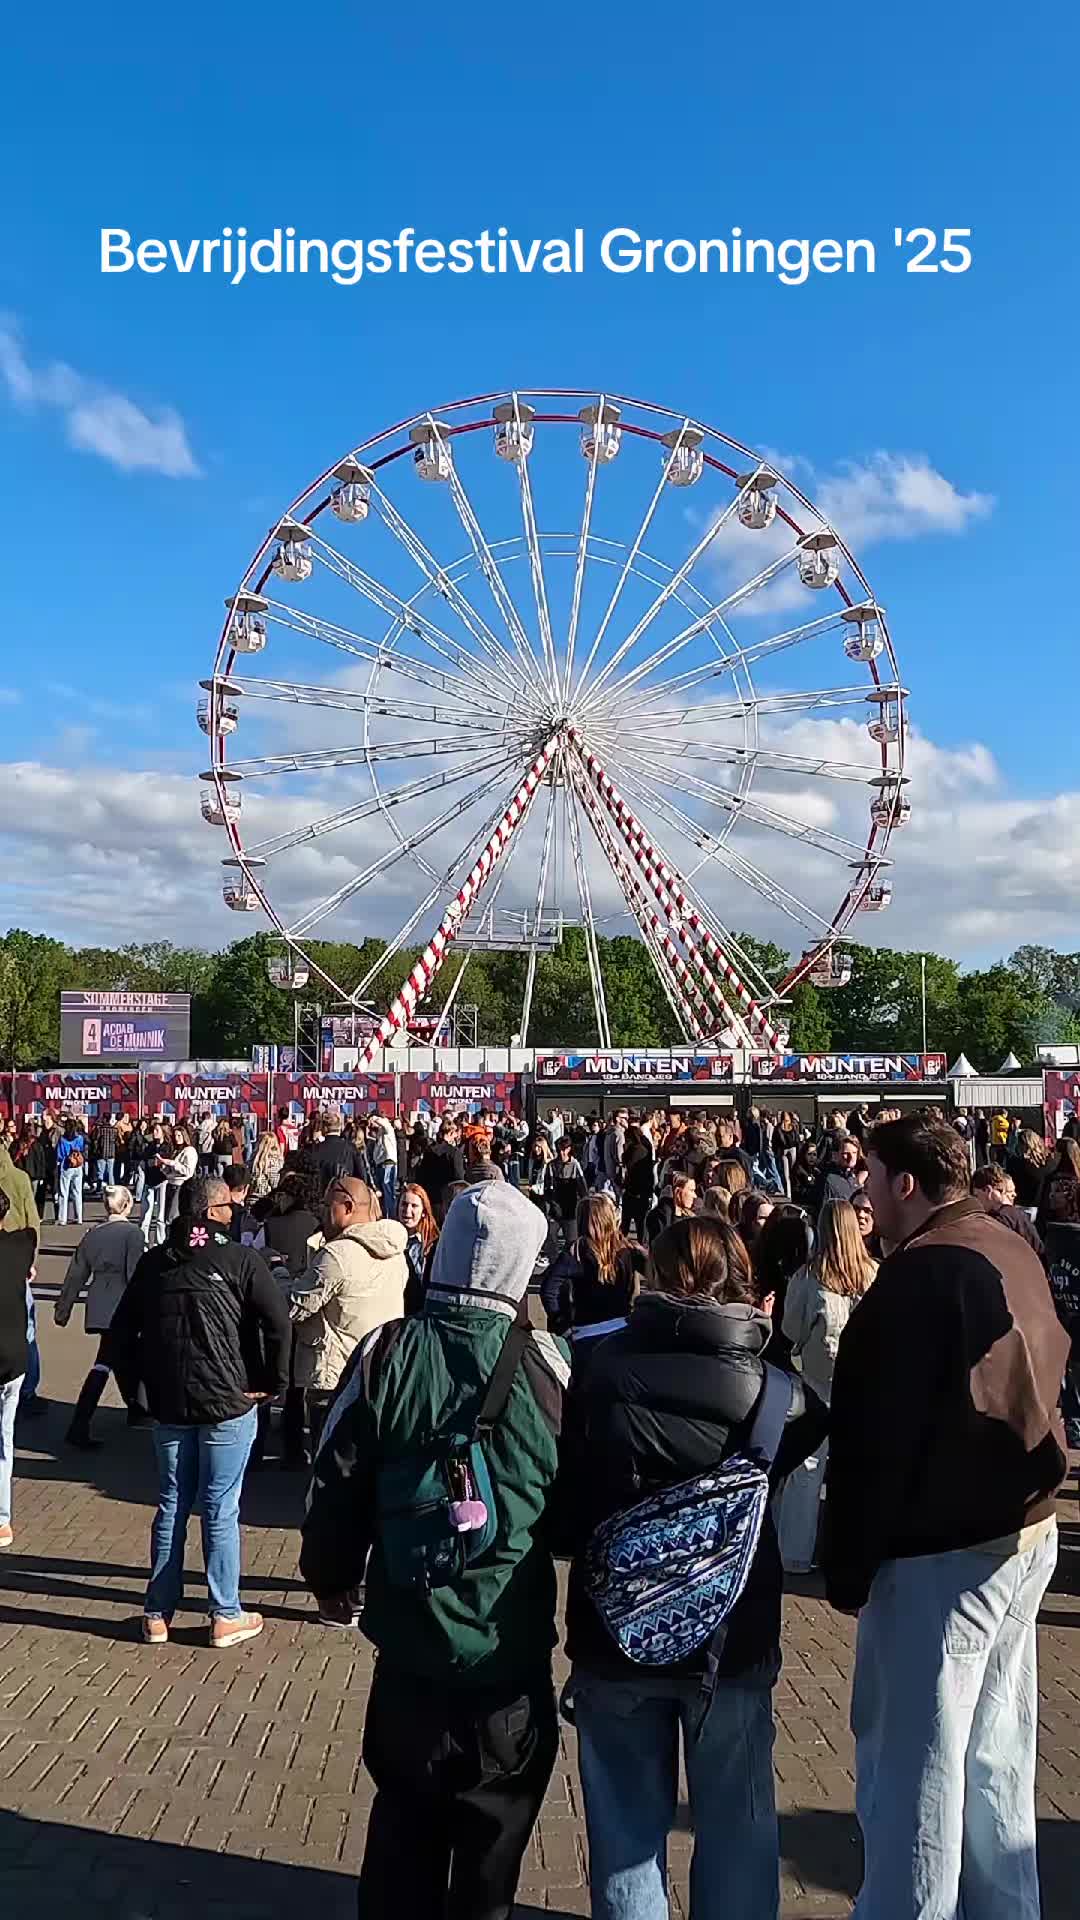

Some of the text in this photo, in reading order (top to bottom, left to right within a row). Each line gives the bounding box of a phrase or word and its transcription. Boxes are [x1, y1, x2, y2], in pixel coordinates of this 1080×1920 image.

[88, 1024, 96, 1040] 4
[110, 1036, 122, 1047] DE
[123, 1030, 164, 1048] MUNNIK
[586, 1058, 689, 1073] MUNTEN
[800, 1058, 902, 1073] MUNTEN
[46, 1087, 106, 1100] MUNTEN
[174, 1087, 236, 1100] MUNTEN
[303, 1087, 364, 1100] MUNTEN
[430, 1085, 491, 1098] MUNTEN
